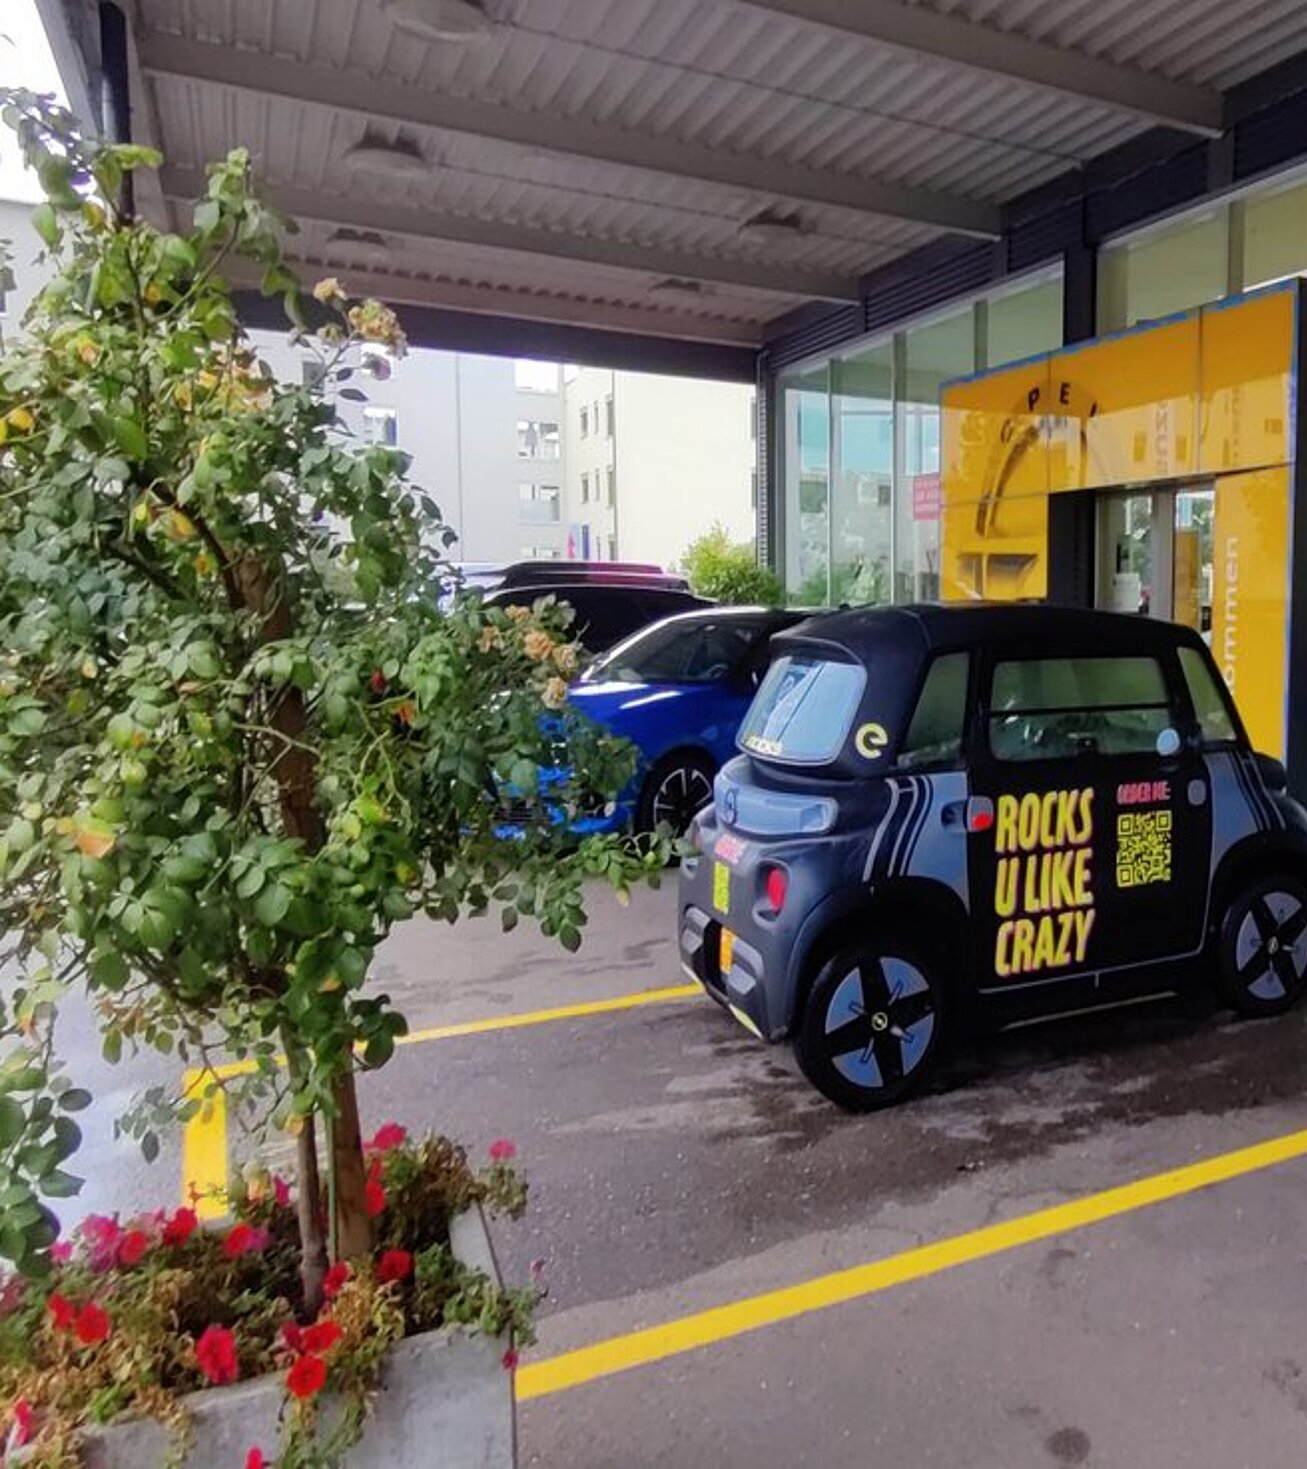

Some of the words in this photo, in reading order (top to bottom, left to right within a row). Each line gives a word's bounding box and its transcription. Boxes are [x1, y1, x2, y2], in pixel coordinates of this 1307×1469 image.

[1224, 538, 1238, 697] ommen
[995, 787, 1094, 853] ROCKS
[995, 857, 1019, 918] U
[1024, 848, 1094, 913] LIKE
[995, 908, 1096, 977] CRAZY
